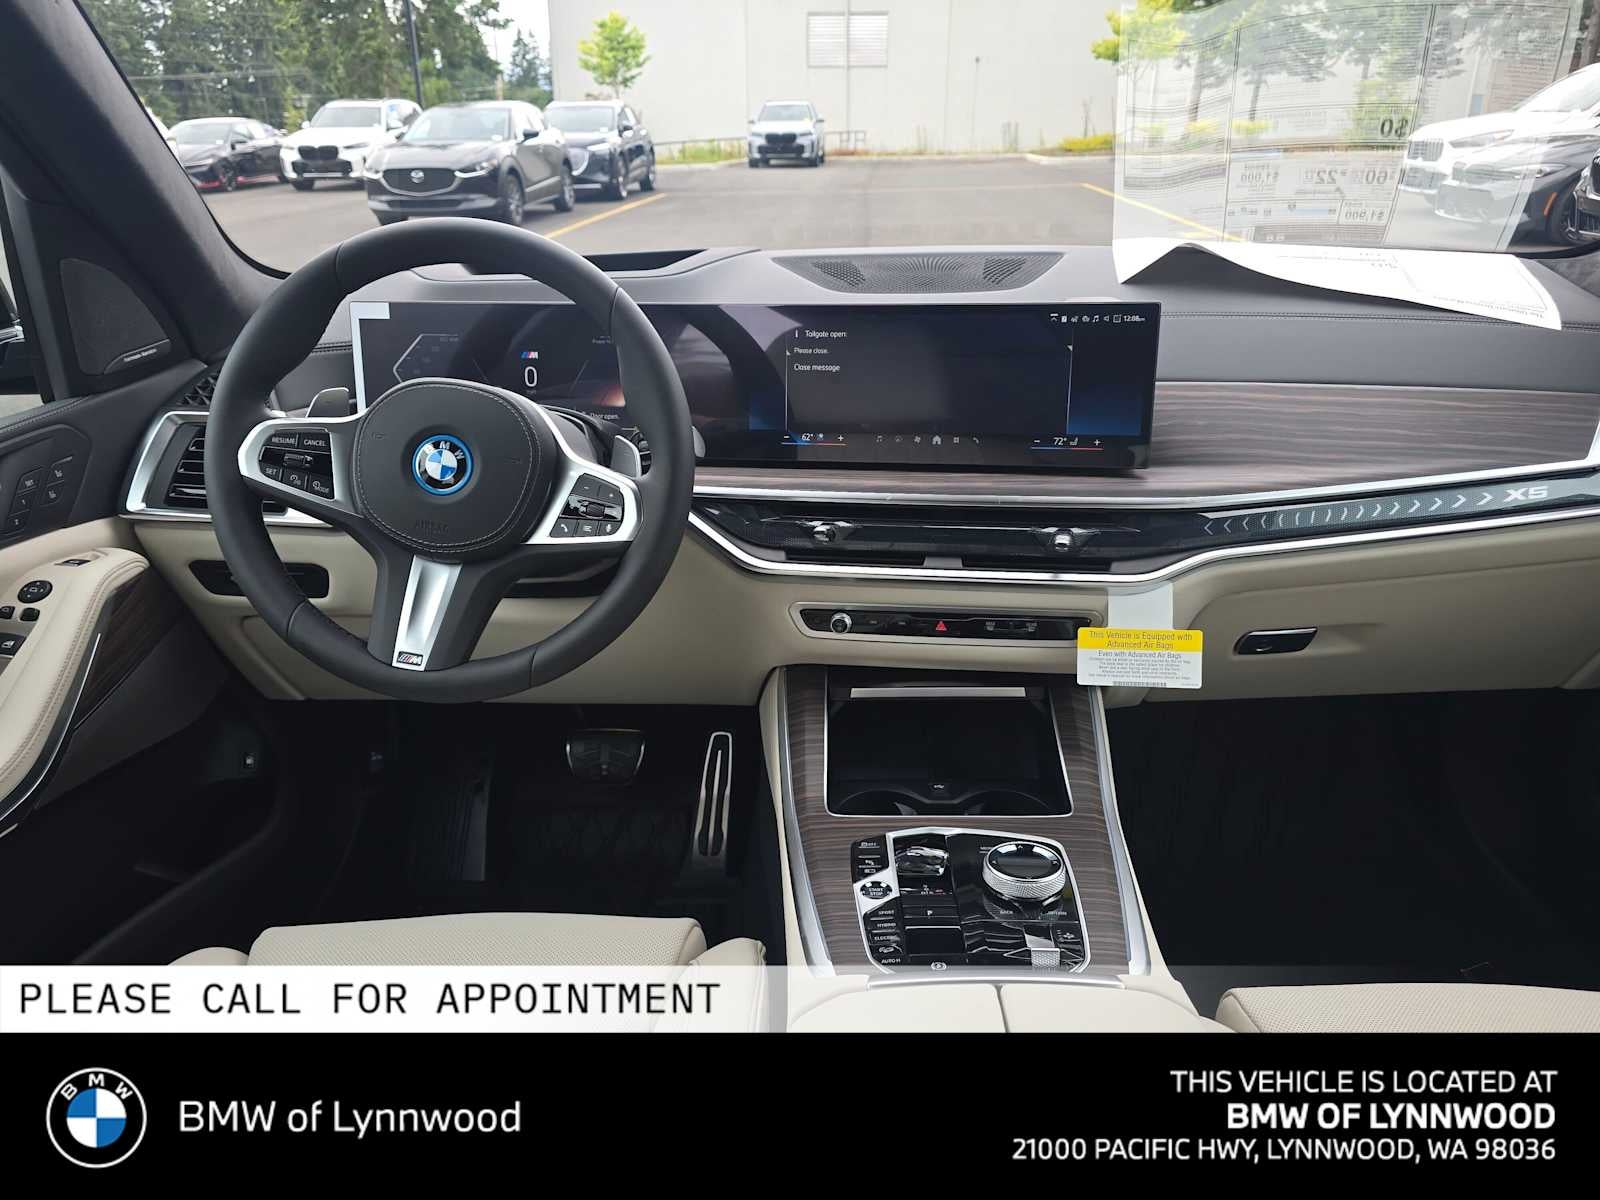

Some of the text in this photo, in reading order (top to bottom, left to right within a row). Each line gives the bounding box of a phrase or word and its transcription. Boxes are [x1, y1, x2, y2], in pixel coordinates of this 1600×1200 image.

[805, 329, 829, 339] Tailgate
[793, 363, 811, 371] Close
[523, 366, 538, 387] 0
[303, 439, 328, 447] CANCEL
[1503, 485, 1549, 502] X5
[1088, 630, 1104, 639] This
[1106, 631, 1132, 640] Vehicle
[1142, 631, 1175, 643] Equipped
[1176, 632, 1193, 641] with
[1106, 640, 1174, 650] Advanced Air Bags
[1114, 650, 1127, 658] with
[1127, 650, 1156, 658] Advanced
[1157, 651, 1167, 659] Air
[1167, 652, 1182, 660] Bags
